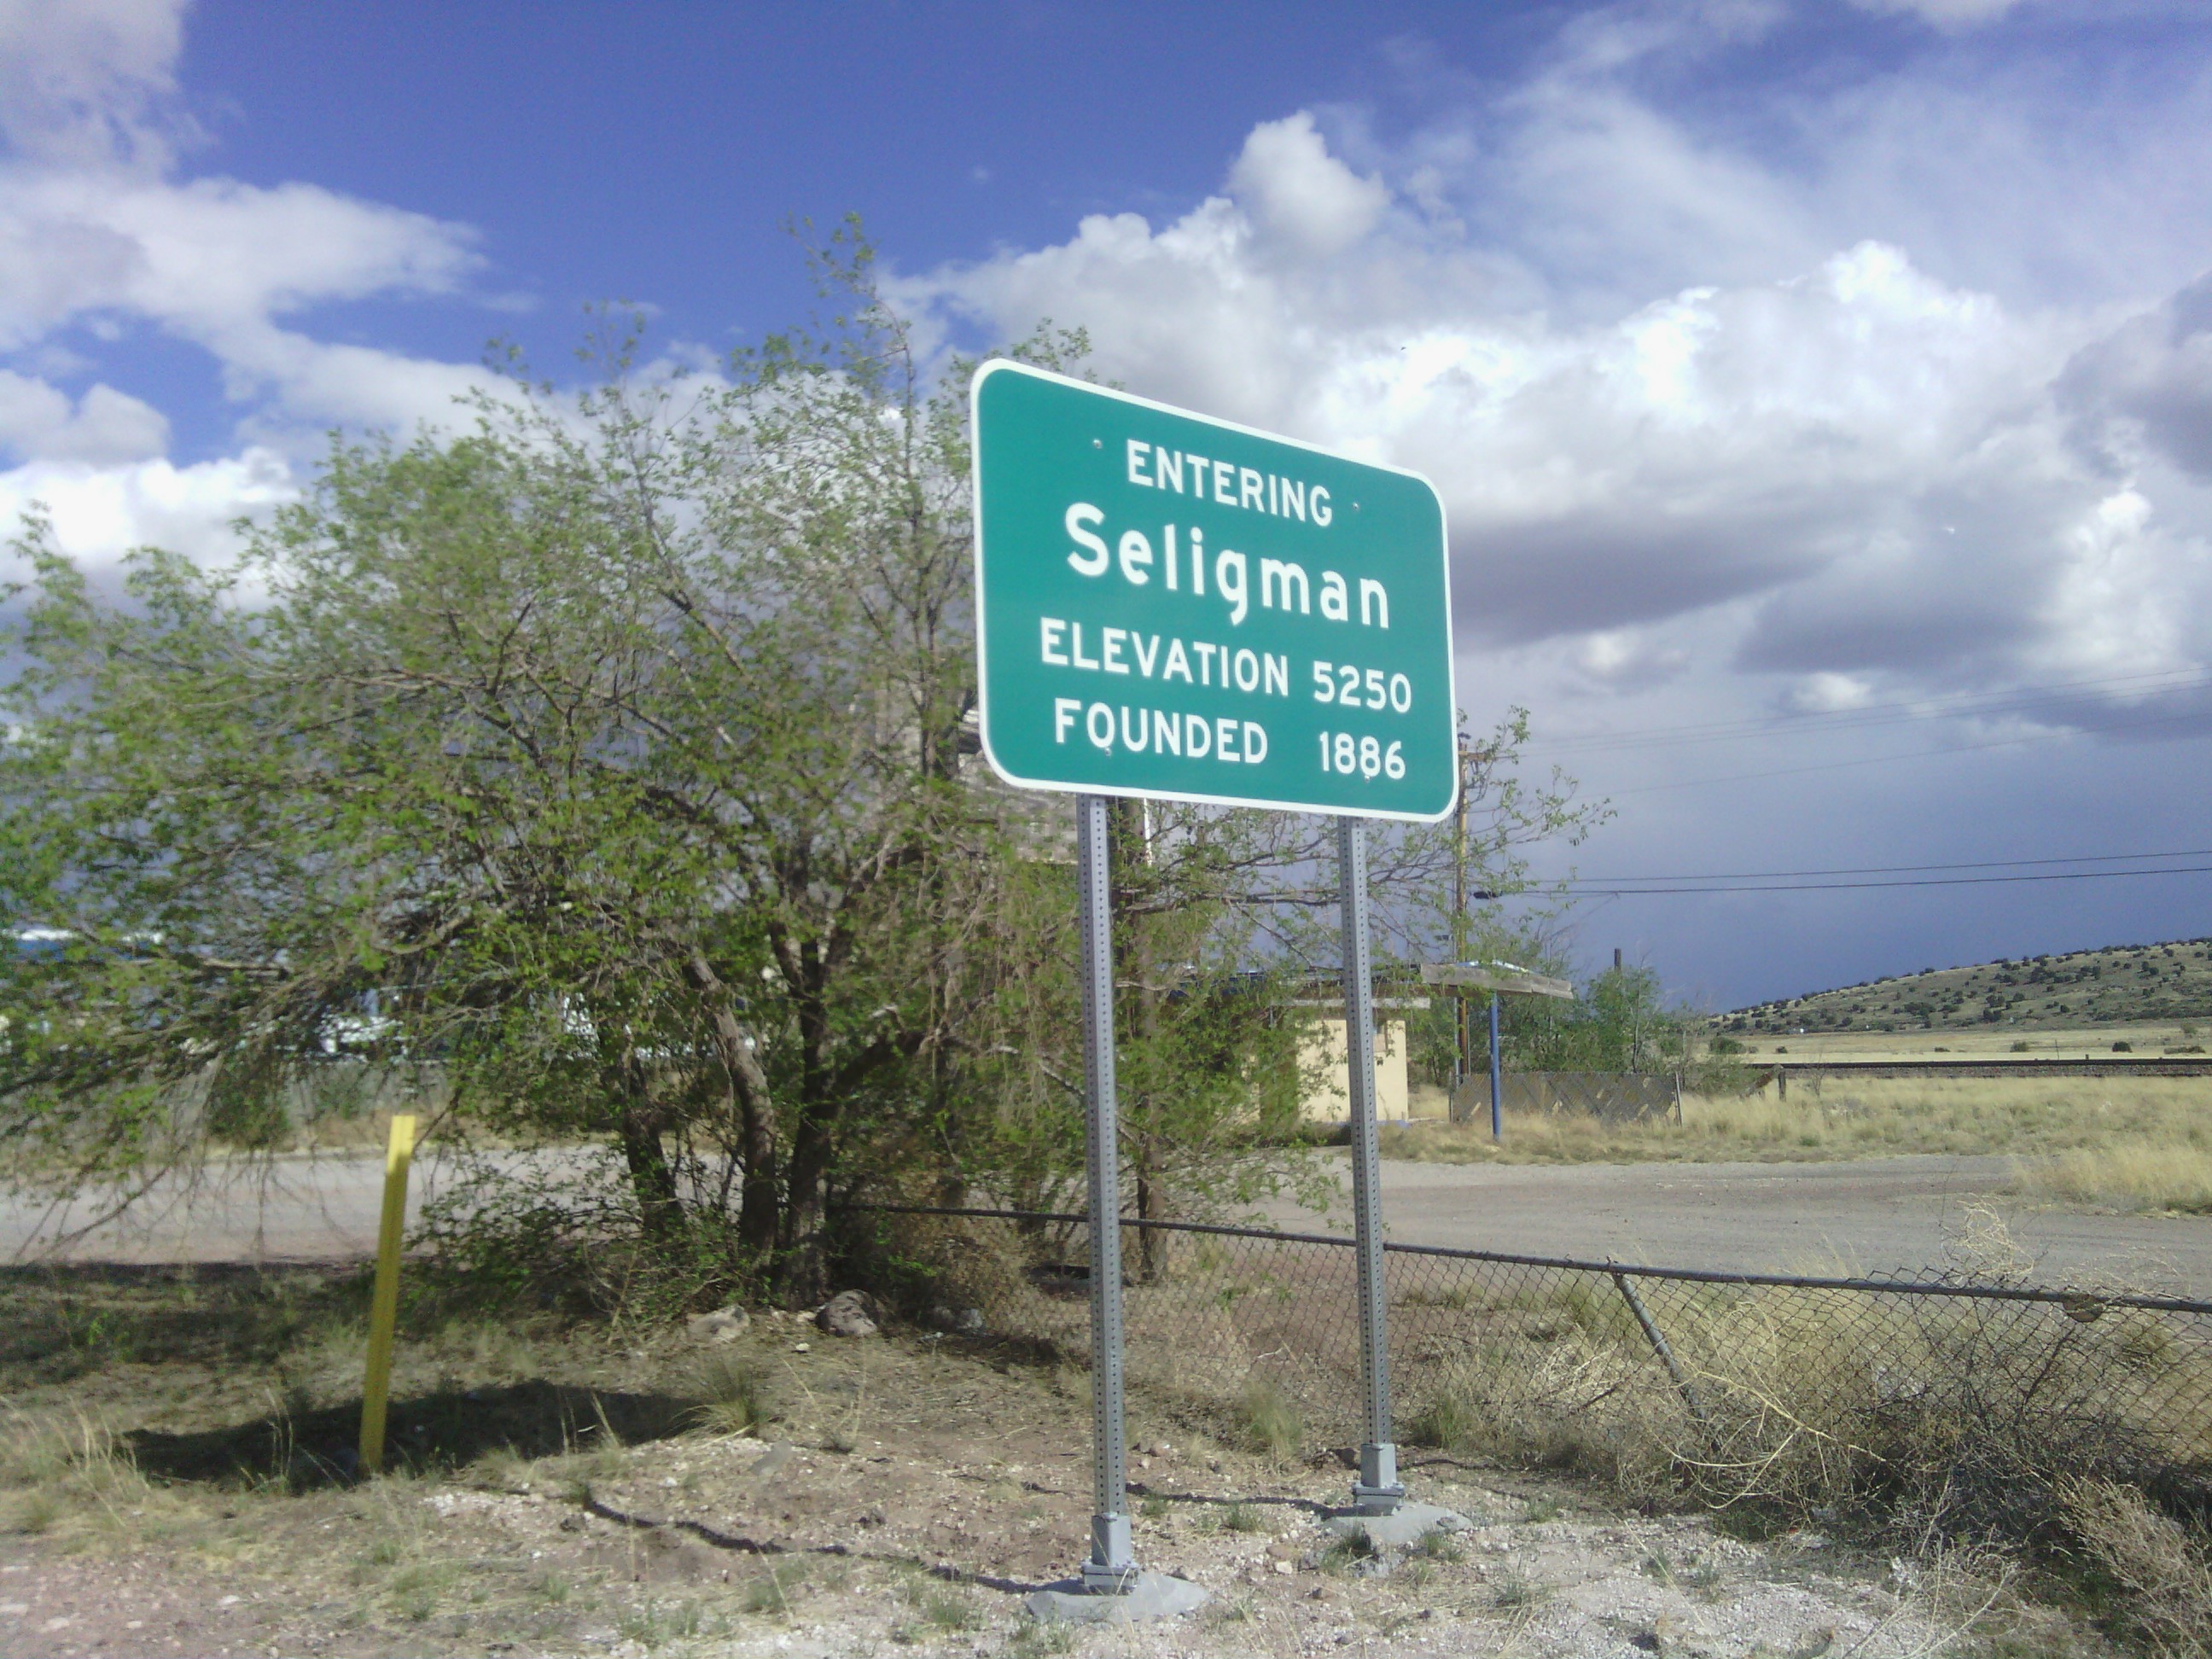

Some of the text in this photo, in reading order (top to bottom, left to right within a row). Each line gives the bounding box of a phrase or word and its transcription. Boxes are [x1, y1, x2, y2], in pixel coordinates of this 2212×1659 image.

[1126, 438, 1333, 528] ENTERING
[1064, 501, 1390, 627] Seligman
[1040, 616, 1413, 714] ELEVATION 5250
[1054, 696, 1407, 780] FOUNDED 1886
